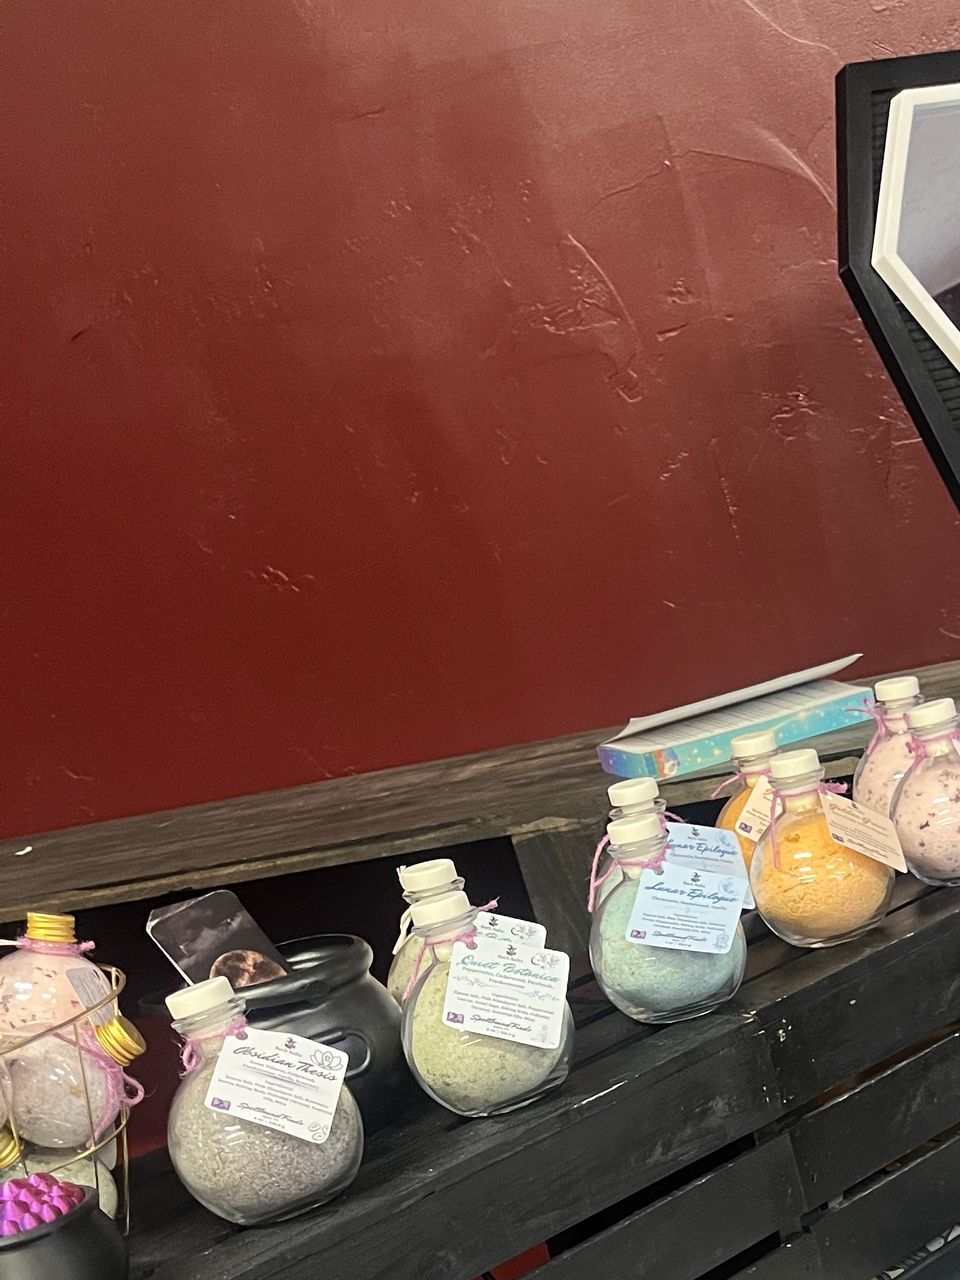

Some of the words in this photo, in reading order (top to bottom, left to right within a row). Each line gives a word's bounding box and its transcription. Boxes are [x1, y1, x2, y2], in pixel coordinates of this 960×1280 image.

[696, 843, 738, 857] Epilogue
[644, 881, 687, 896] Lunar
[686, 888, 740, 905] Epilogue
[456, 954, 500, 970] Quiet
[502, 962, 560, 983] Botanica
[232, 1045, 297, 1069] Obsidian
[295, 1060, 338, 1082] Thesis
